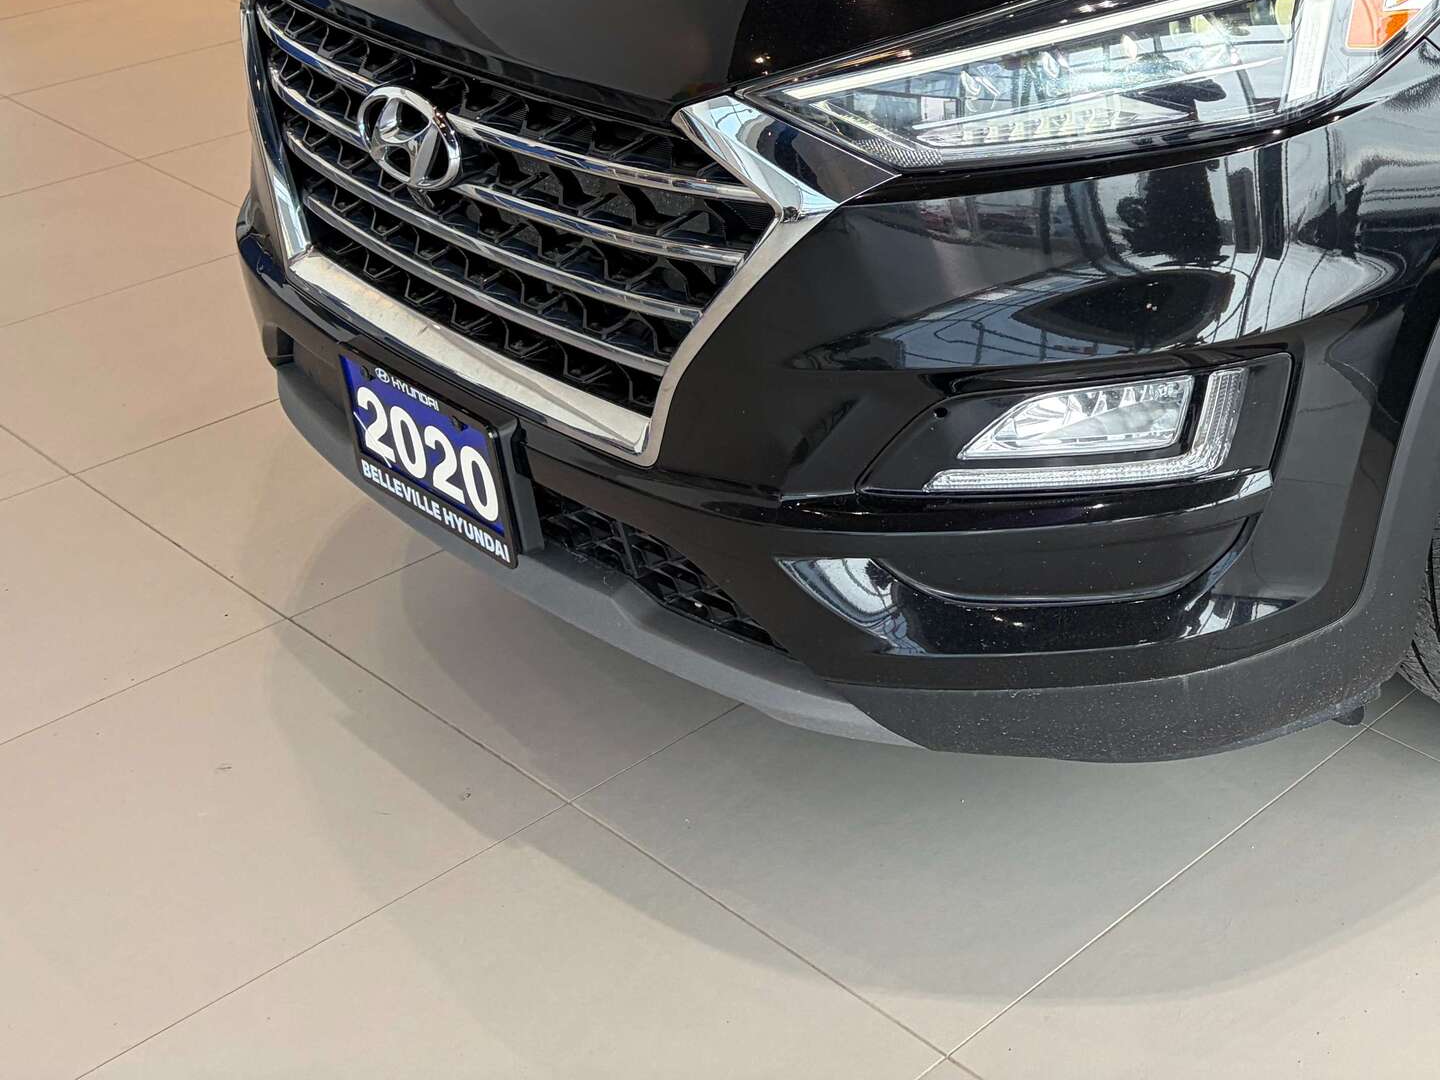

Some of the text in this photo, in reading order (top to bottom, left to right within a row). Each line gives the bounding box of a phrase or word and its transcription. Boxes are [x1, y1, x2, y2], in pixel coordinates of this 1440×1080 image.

[391, 376, 440, 411] HYUNDAI
[357, 386, 499, 522] 2020
[361, 459, 511, 563] BELLEVILLE HYUNDAI
